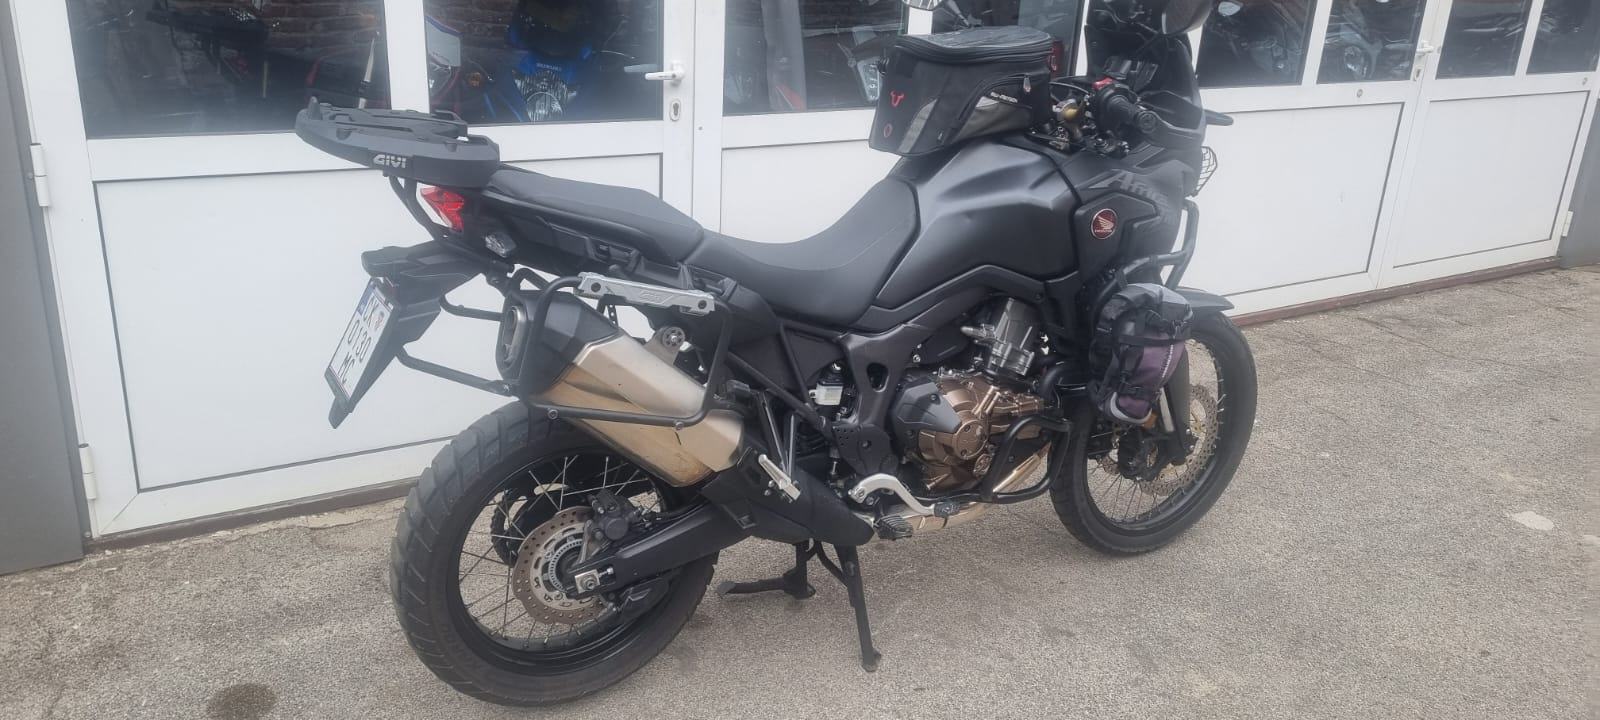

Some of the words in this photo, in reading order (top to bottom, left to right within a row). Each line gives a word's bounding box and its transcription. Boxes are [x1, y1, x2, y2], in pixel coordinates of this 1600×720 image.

[373, 154, 407, 169] GIVI
[347, 319, 372, 364] 0130
[337, 351, 355, 385] MC
